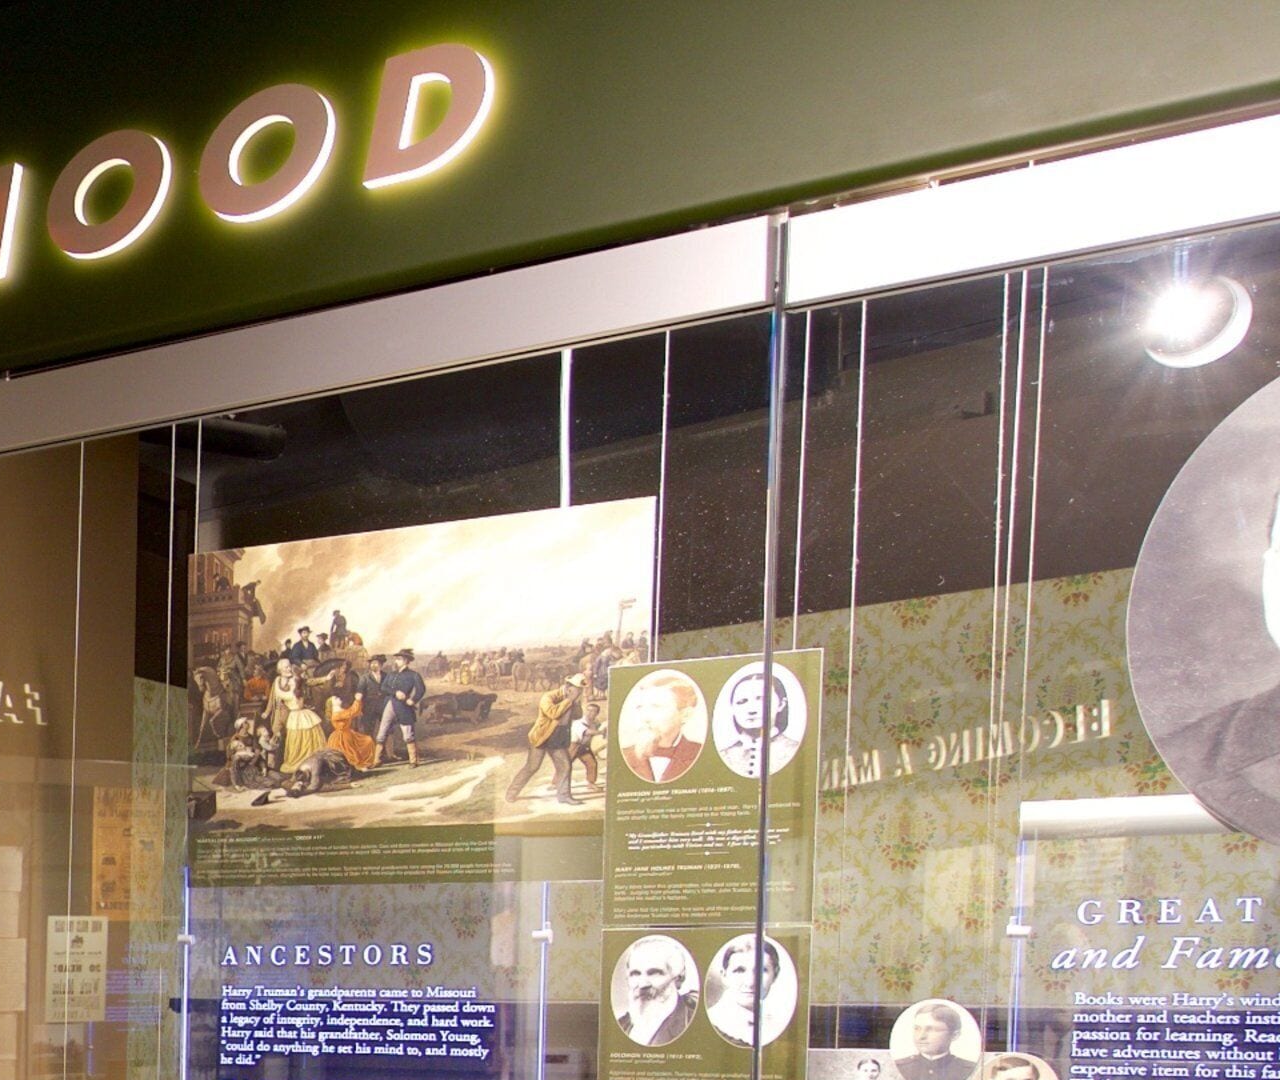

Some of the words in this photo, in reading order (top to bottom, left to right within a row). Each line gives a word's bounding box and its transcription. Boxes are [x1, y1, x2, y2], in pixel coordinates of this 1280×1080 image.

[1077, 898, 1262, 925] GREAT
[221, 944, 433, 966] ANCESTORS
[1051, 935, 1145, 969] and
[1161, 936, 1280, 969] Fam
[221, 985, 253, 999] Harry
[254, 985, 306, 996] Truman's
[307, 985, 378, 999] grandparents
[378, 989, 409, 997] came
[410, 988, 424, 997] to
[425, 986, 477, 997] Missouri
[1073, 992, 1127, 1005] Books
[1129, 996, 1170, 1005] were
[1171, 992, 1236, 1010] Harry's
[221, 999, 248, 1010] from
[247, 999, 284, 1013] Shelby
[285, 999, 330, 1013] County,
[332, 1000, 390, 1014] Kentucky.
[390, 1001, 422, 1014] They
[421, 1001, 461, 1015] passed
[460, 1001, 497, 1013] down
[220, 1015, 228, 1023] a
[229, 1012, 261, 1026] legacy
[262, 1013, 276, 1024] of
[275, 1013, 324, 1027] integrity,
[326, 1014, 404, 1028] independence,
[406, 1015, 429, 1026] and
[431, 1015, 458, 1027] hard
[460, 1016, 494, 1027] work.
[1072, 1009, 1133, 1023] mother
[1135, 1010, 1171, 1023] and
[1172, 1011, 1243, 1024] teachers
[220, 1026, 252, 1040] Harry
[253, 1026, 274, 1038] said
[276, 1027, 299, 1038] that
[298, 1027, 317, 1039] his
[318, 1028, 384, 1042] grandfather,
[386, 1029, 437, 1041] Solomon
[439, 1030, 482, 1044] Young,
[1071, 1027, 1130, 1045] passion
[1137, 1028, 1160, 1041] for
[1165, 1028, 1237, 1046] learning.
[220, 1039, 254, 1051] "could
[256, 1040, 271, 1052] do
[272, 1041, 321, 1055] anything
[320, 1042, 336, 1053] he
[337, 1044, 353, 1053] set
[354, 1042, 372, 1054] his
[373, 1043, 404, 1055] mind
[406, 1045, 422, 1057] to,
[425, 1044, 447, 1056] and
[449, 1045, 490, 1059] mostly
[1070, 1044, 1110, 1057] have
[1111, 1044, 1203, 1059] adventures
[1204, 1046, 1276, 1061] without
[220, 1053, 234, 1064] he
[235, 1053, 262, 1065] did."
[1069, 1061, 1147, 1080] expensive
[1151, 1063, 1192, 1077] item
[1193, 1064, 1222, 1078] for
[1223, 1065, 1259, 1078] this
